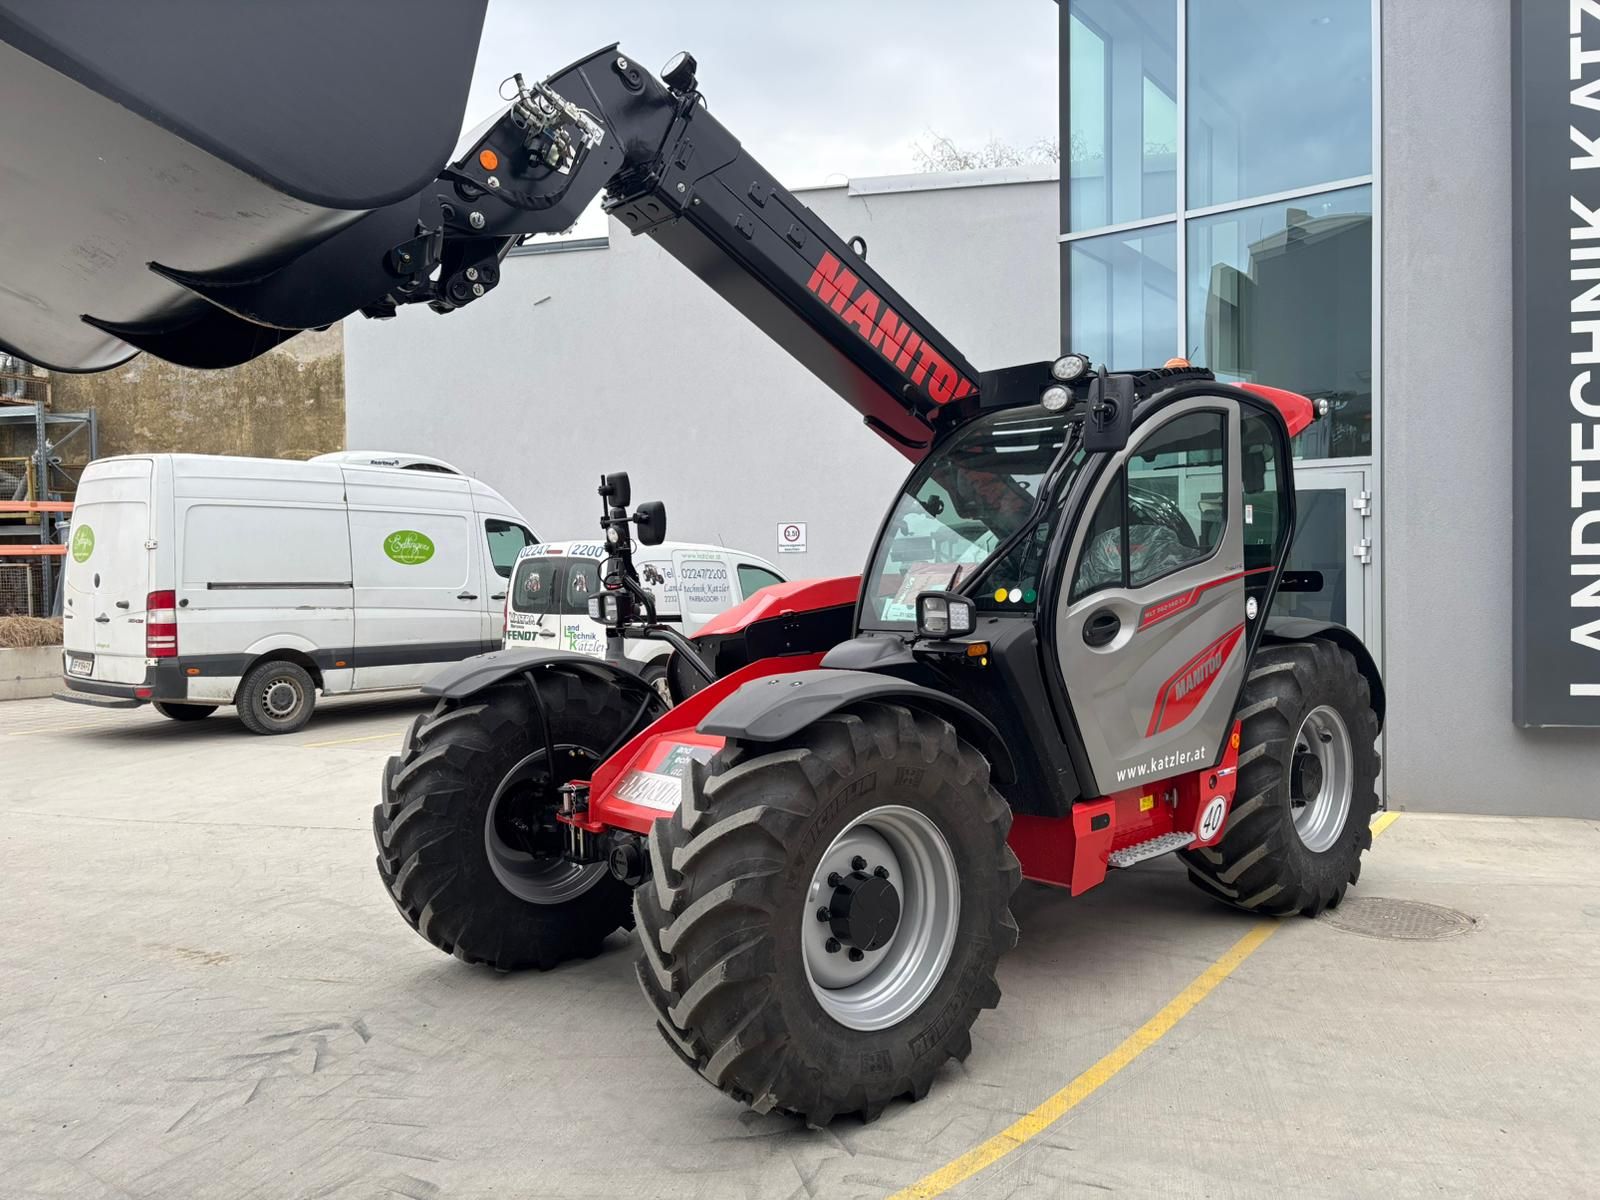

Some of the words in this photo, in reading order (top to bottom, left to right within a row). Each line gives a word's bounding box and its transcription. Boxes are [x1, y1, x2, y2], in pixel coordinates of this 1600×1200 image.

[520, 544, 550, 558] 02247
[571, 544, 604, 558] 2200
[681, 567, 728, 580] 02247/2200
[507, 630, 539, 641] FENDT
[1174, 652, 1223, 701] MANITOU
[1116, 745, 1206, 783] www.katzler.at
[1203, 803, 1223, 834] 40
